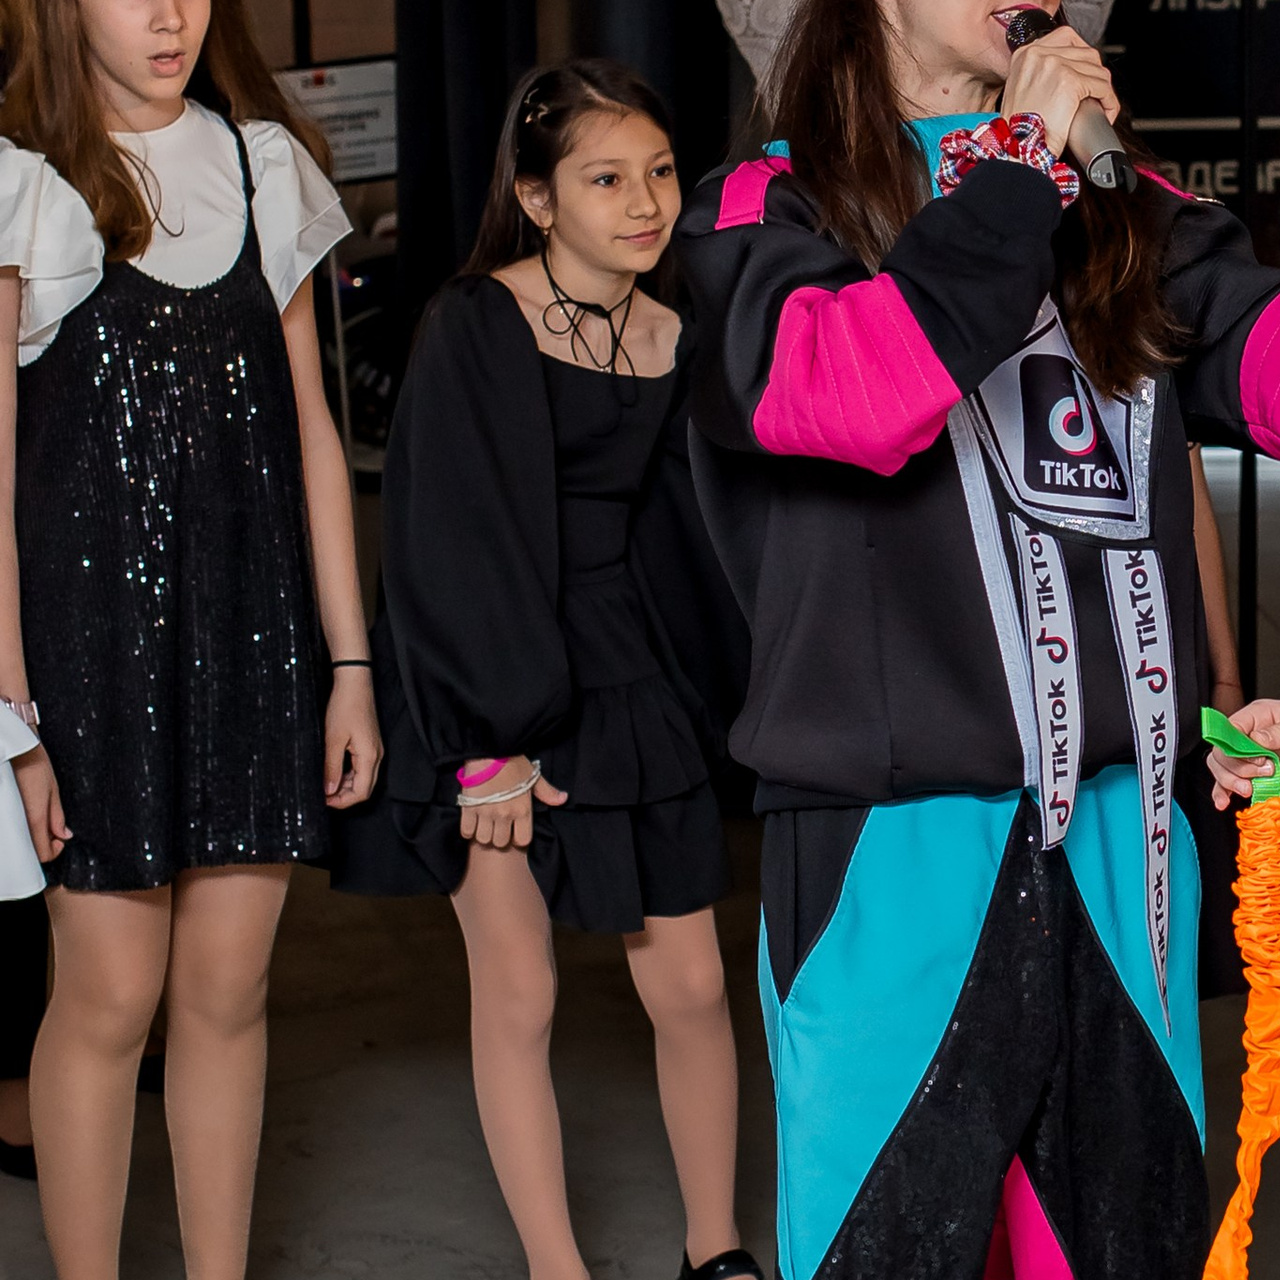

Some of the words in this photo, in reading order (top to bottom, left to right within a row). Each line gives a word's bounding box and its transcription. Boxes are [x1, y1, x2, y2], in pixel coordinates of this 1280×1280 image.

[1040, 460, 1121, 491] TikTok
[1124, 550, 1158, 654] TikTok
[1047, 677, 1068, 785] TikTok
[1150, 711, 1167, 816] TikTok
